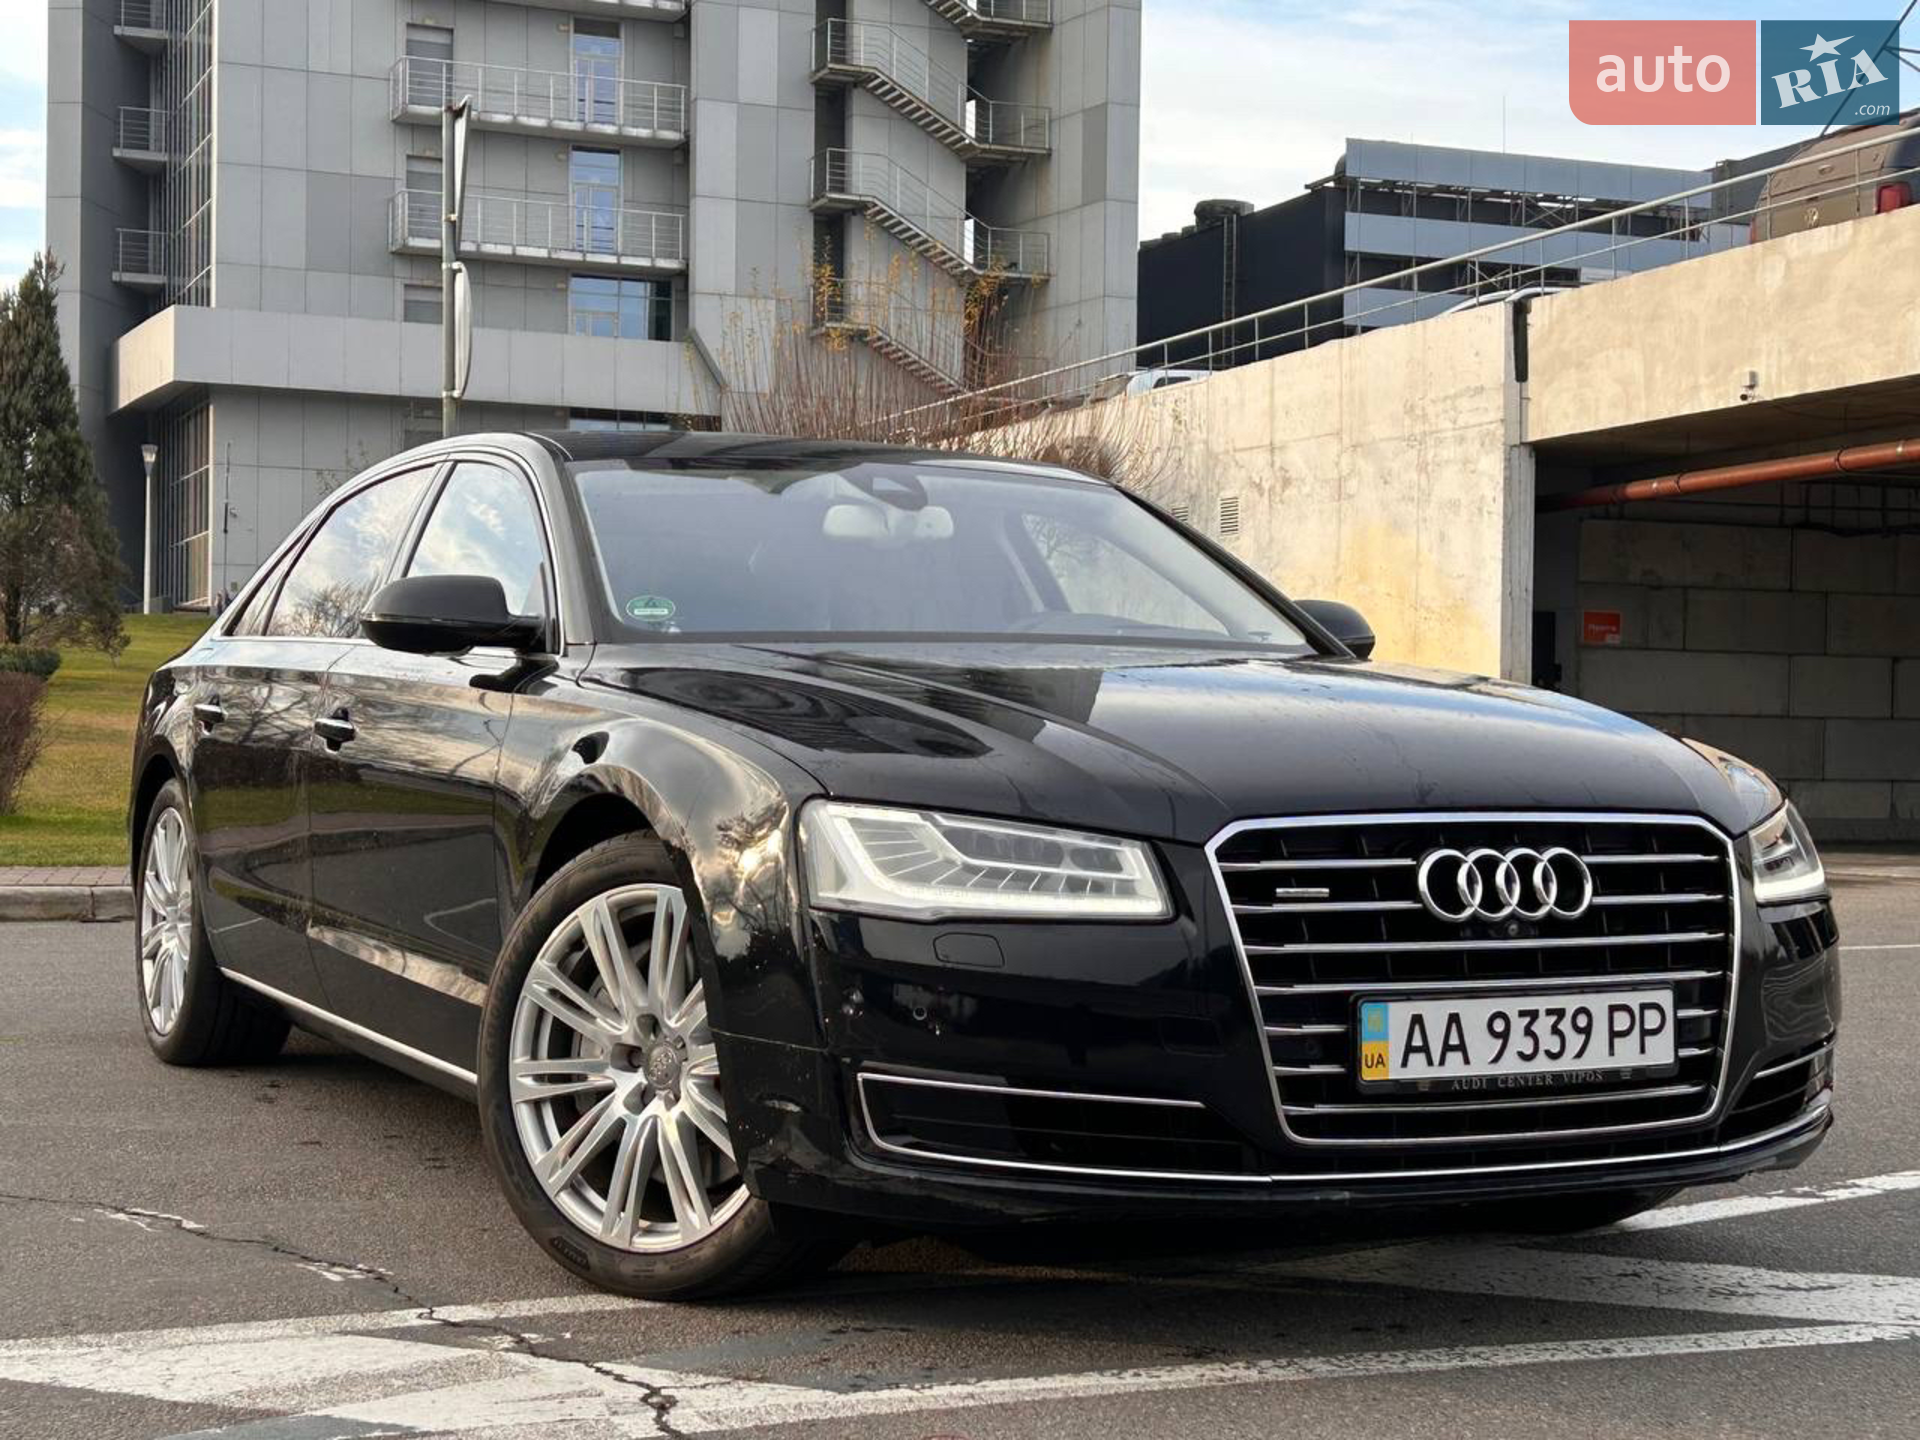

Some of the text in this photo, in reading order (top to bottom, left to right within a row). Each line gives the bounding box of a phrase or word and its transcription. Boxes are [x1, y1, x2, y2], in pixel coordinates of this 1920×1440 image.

[1400, 1002, 1667, 1069] AA 9339 PP
[1364, 1052, 1386, 1069] UA
[1451, 1077, 1488, 1091] AUDI
[1497, 1073, 1554, 1088] CENTER
